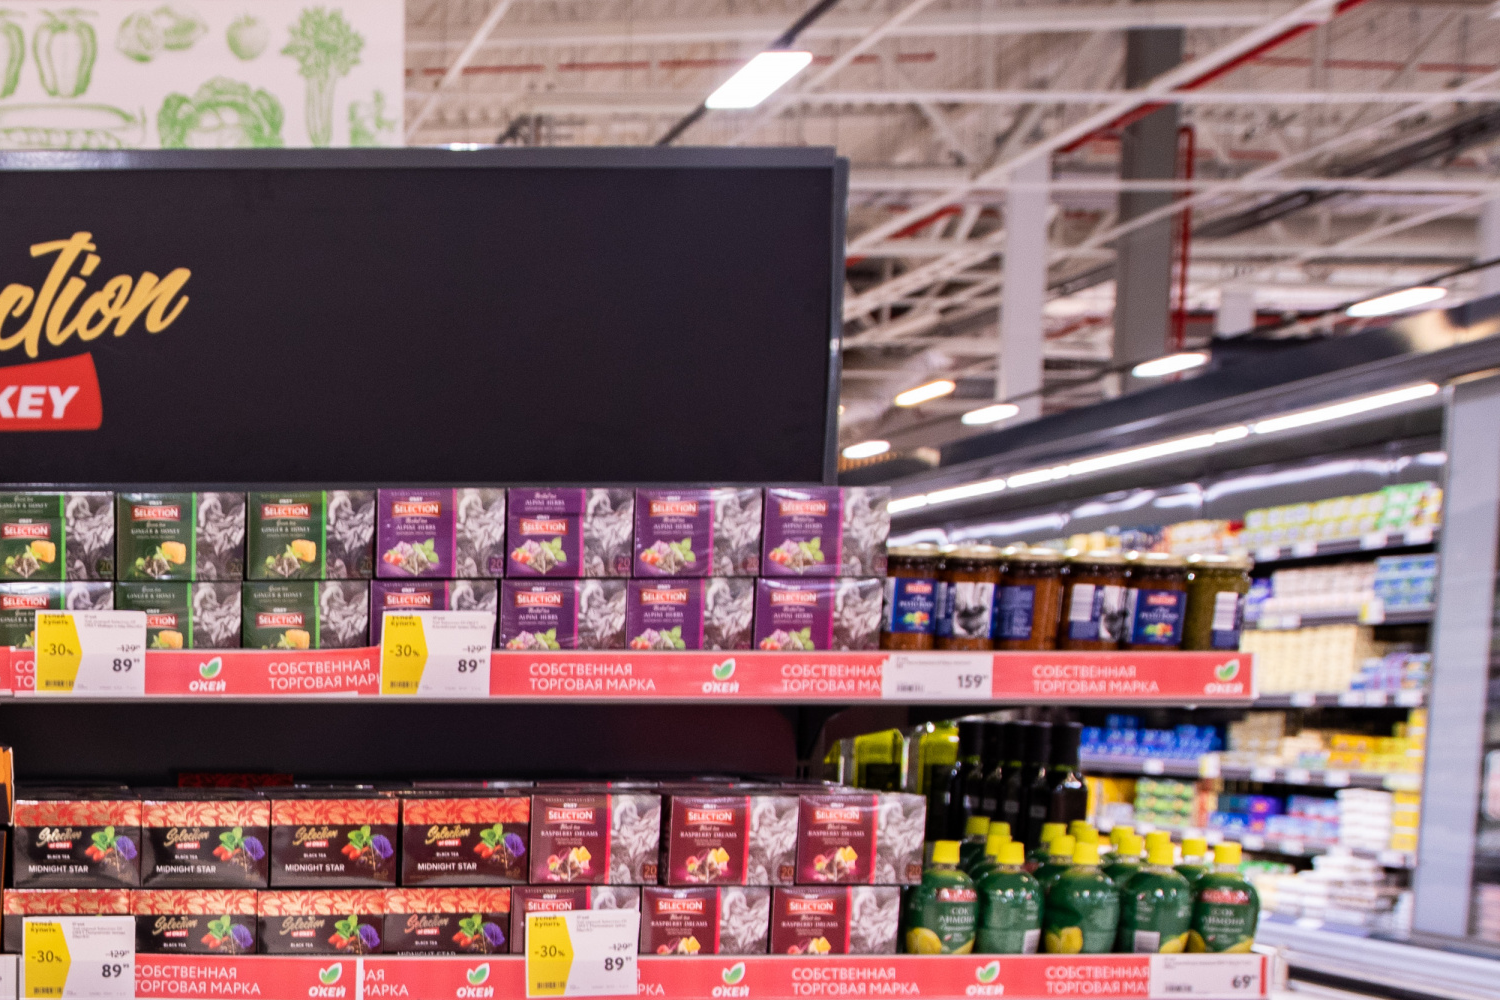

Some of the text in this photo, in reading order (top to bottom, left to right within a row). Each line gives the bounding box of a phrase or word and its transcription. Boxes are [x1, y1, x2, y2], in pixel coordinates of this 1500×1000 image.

[4, 525, 48, 536] SELECTION
[643, 591, 687, 603] SELECTION
[259, 615, 304, 626] SELECTION
[688, 811, 732, 822] SELECTION
[28, 865, 89, 873] MIDNIGHT STAR
[285, 864, 345, 872] MIDNIGHT STAR
[791, 967, 896, 981] СОБСТВЕННАЯ
[791, 982, 920, 996] ТОРГОВАЯ МАРКА
